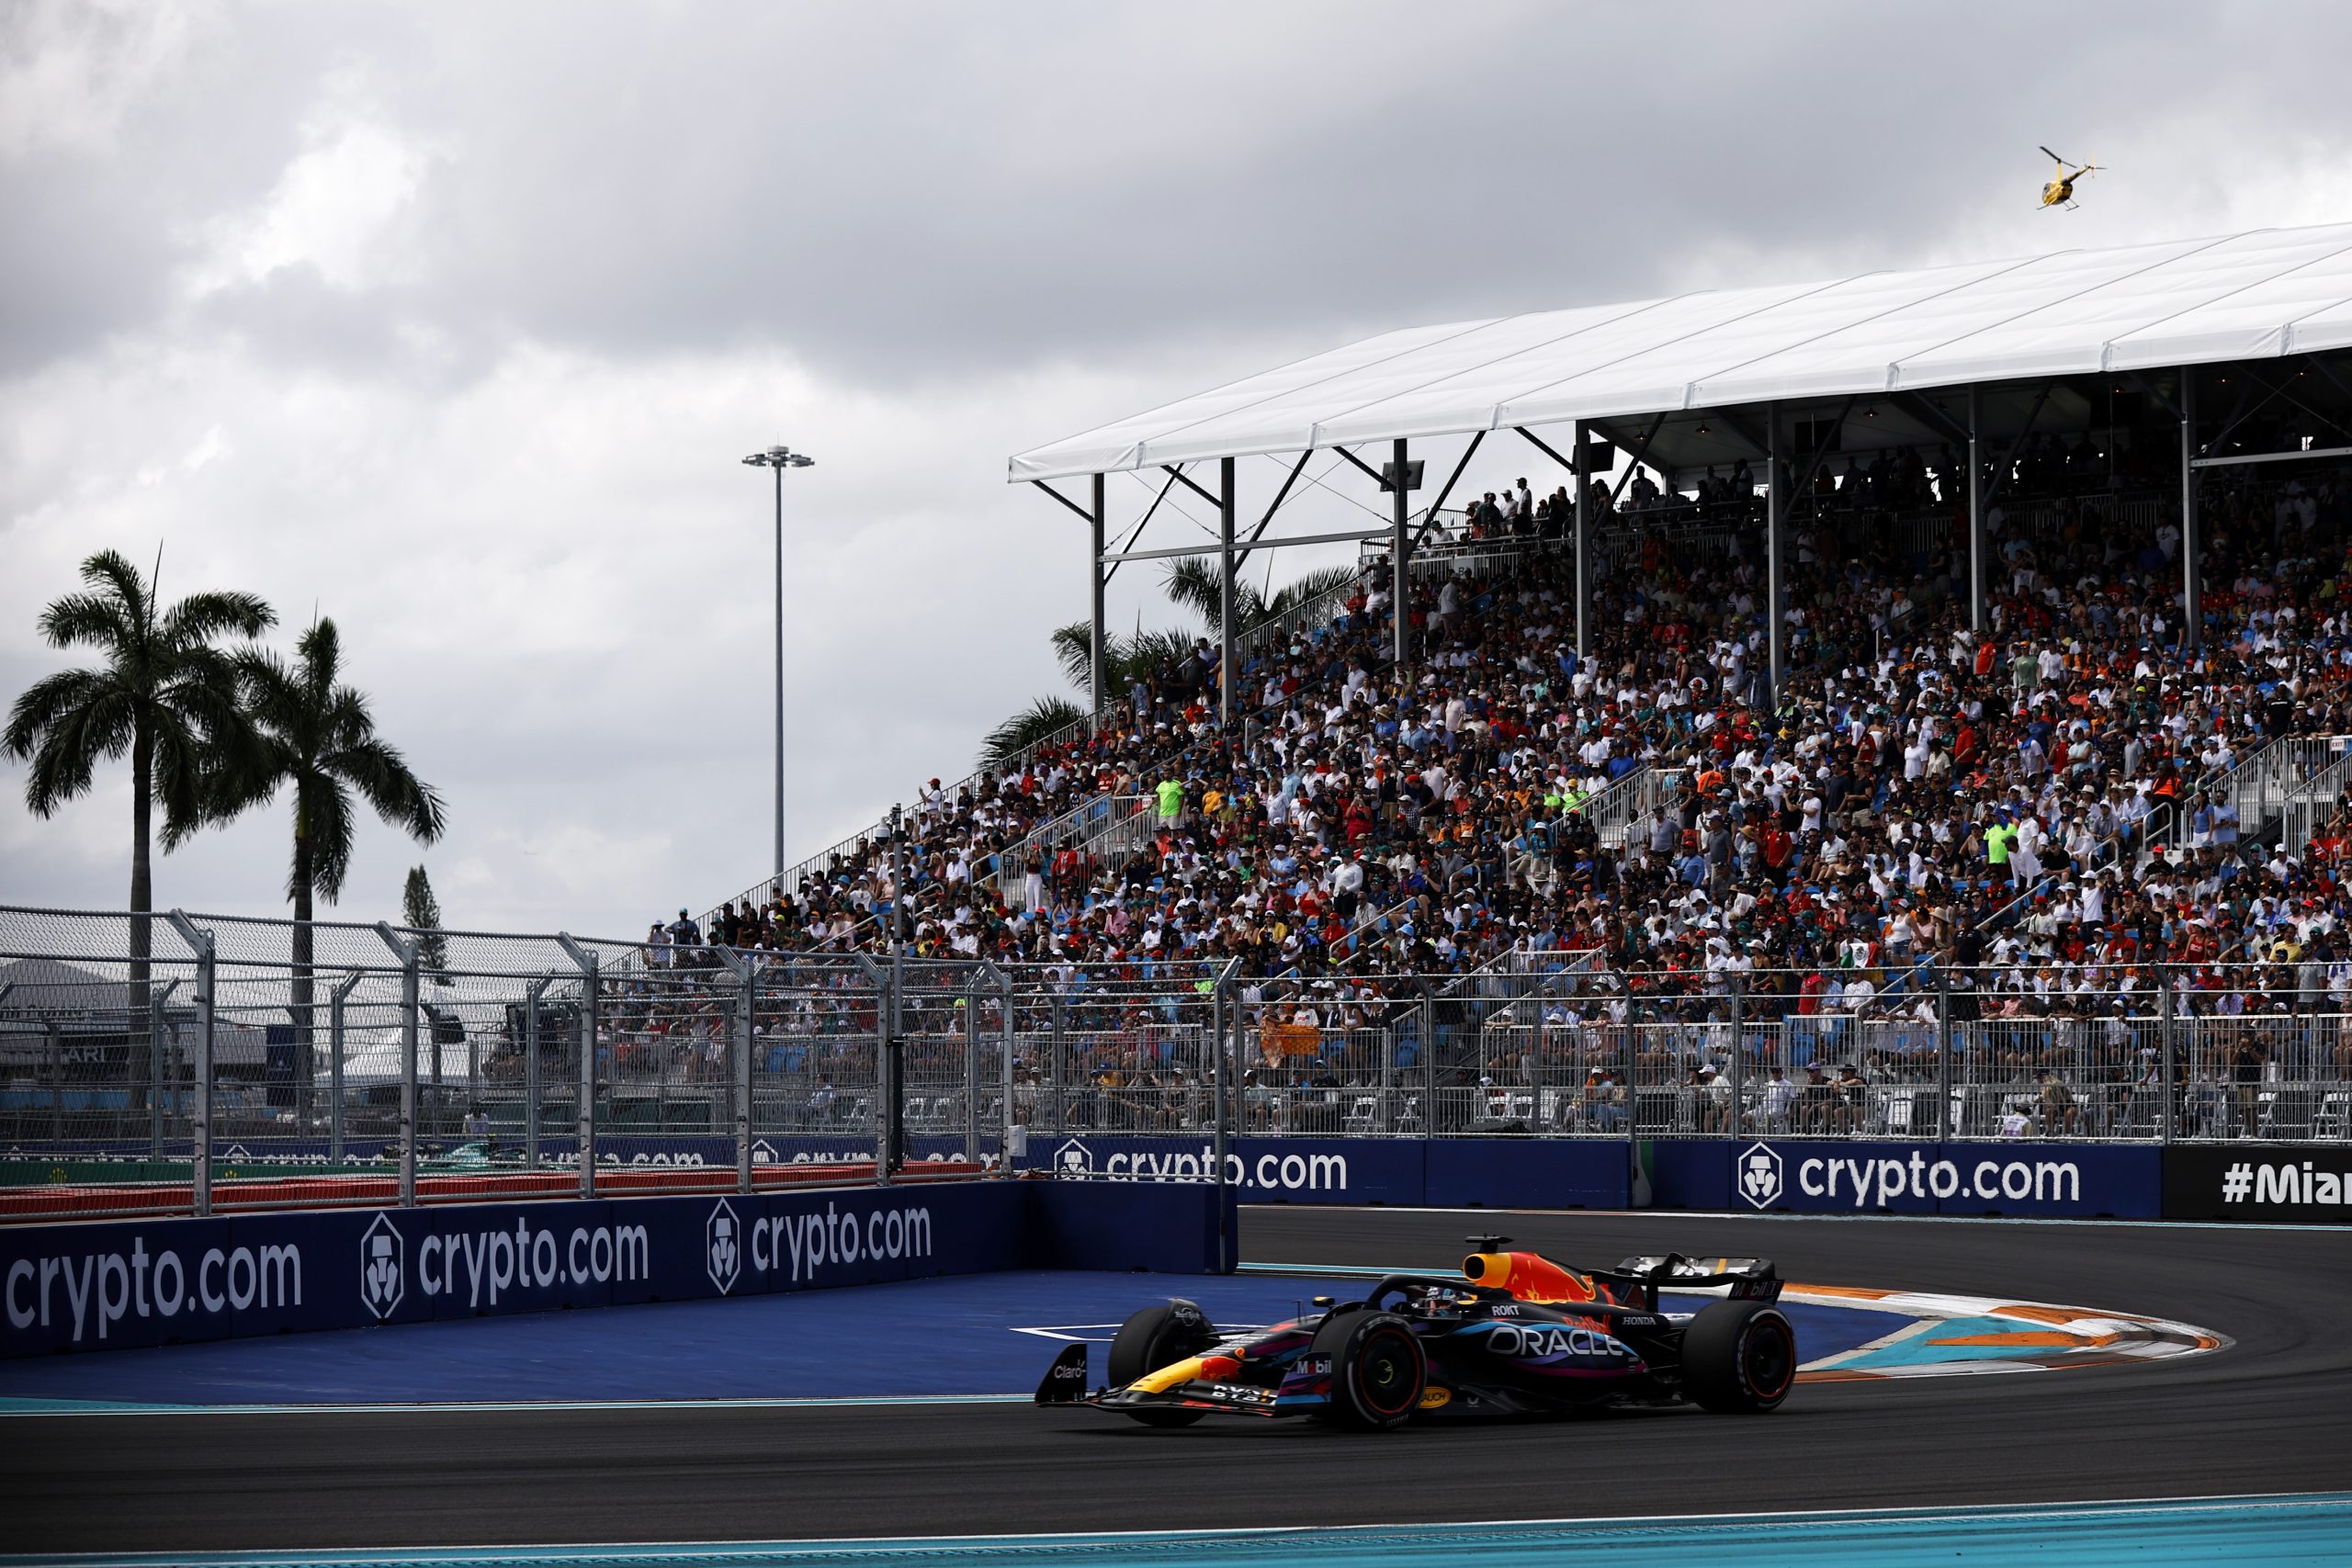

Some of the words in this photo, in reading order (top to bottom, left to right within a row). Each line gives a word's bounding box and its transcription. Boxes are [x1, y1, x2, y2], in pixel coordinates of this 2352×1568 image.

[1799, 1150, 2081, 1207] crypto.com
[752, 1201, 932, 1281] crypto.com
[419, 1215, 650, 1307] crypto.com
[6, 1236, 301, 1342] crypto.com
[1491, 1304, 1521, 1316] ROKT
[1623, 1316, 1657, 1325] HONDA
[1486, 1326, 1624, 1357] ORACLE
[1054, 1365, 1083, 1379] Claro
[1296, 1359, 1332, 1375] Mobil
